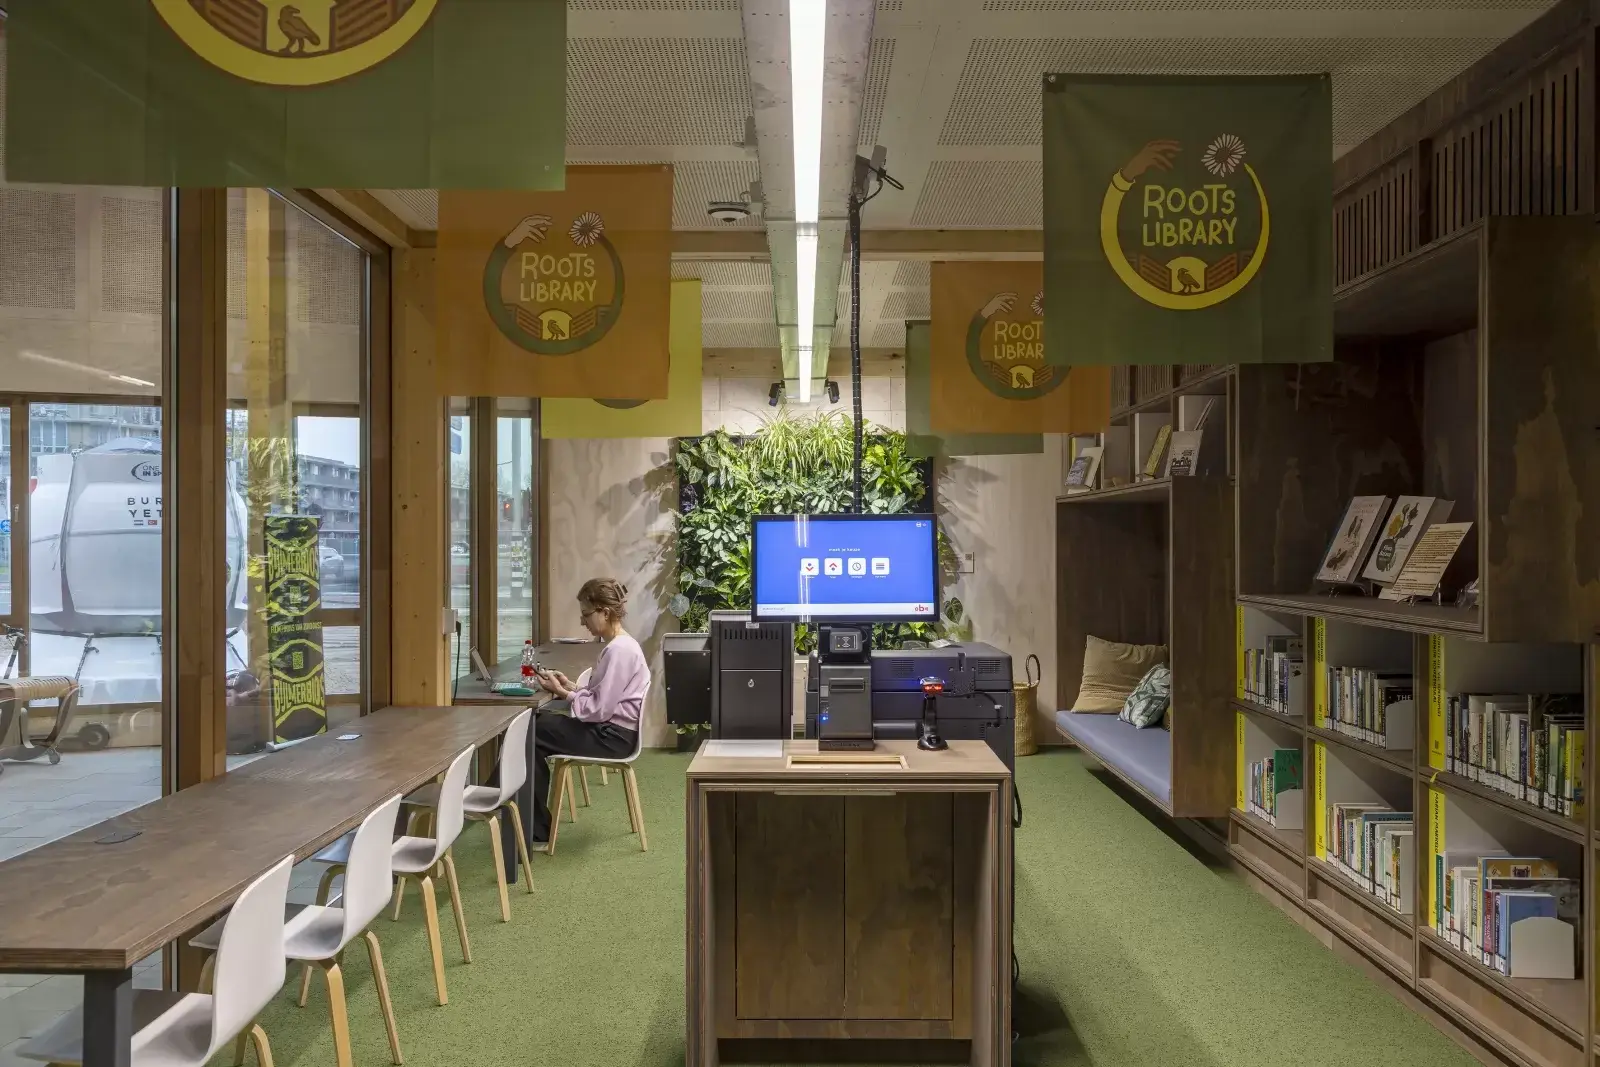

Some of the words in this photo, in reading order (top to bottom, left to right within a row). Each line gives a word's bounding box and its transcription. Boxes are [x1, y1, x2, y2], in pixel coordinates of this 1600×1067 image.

[1143, 184, 1236, 218] ROOTS
[1143, 216, 1238, 247] LIBRARY
[520, 252, 595, 280] ROOTS
[520, 279, 597, 303] LIBRARY
[994, 320, 1044, 342] ROOT
[994, 341, 1044, 360] LIBRAR
[127, 497, 162, 505] BUR
[128, 509, 162, 518] YET
